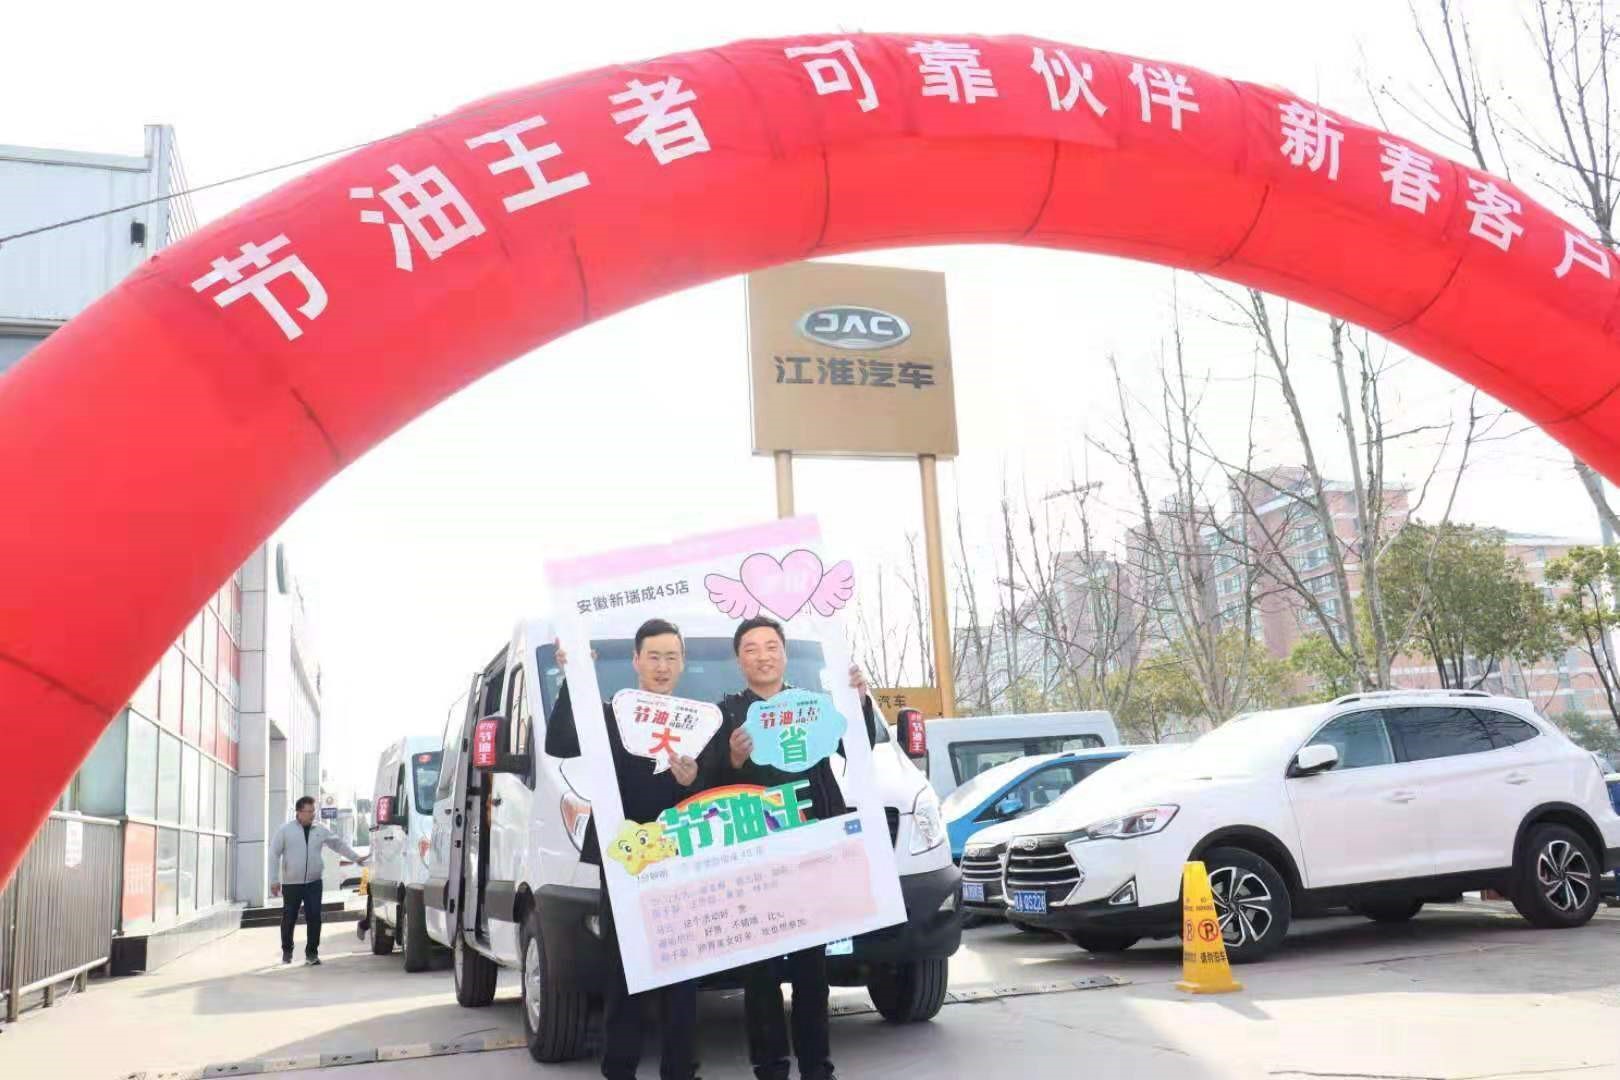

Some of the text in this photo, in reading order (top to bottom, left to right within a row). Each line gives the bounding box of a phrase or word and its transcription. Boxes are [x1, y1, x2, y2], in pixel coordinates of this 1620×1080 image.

[192, 38, 1612, 341] 节油王者 可靠伙伴 新春客户
[814, 313, 894, 335] JAC
[774, 355, 935, 389] 江淮汽车
[576, 579, 689, 615] 安徽新瑞成4S店
[648, 728, 681, 754] 大
[779, 726, 808, 764] 省
[662, 779, 818, 858] 节油王
